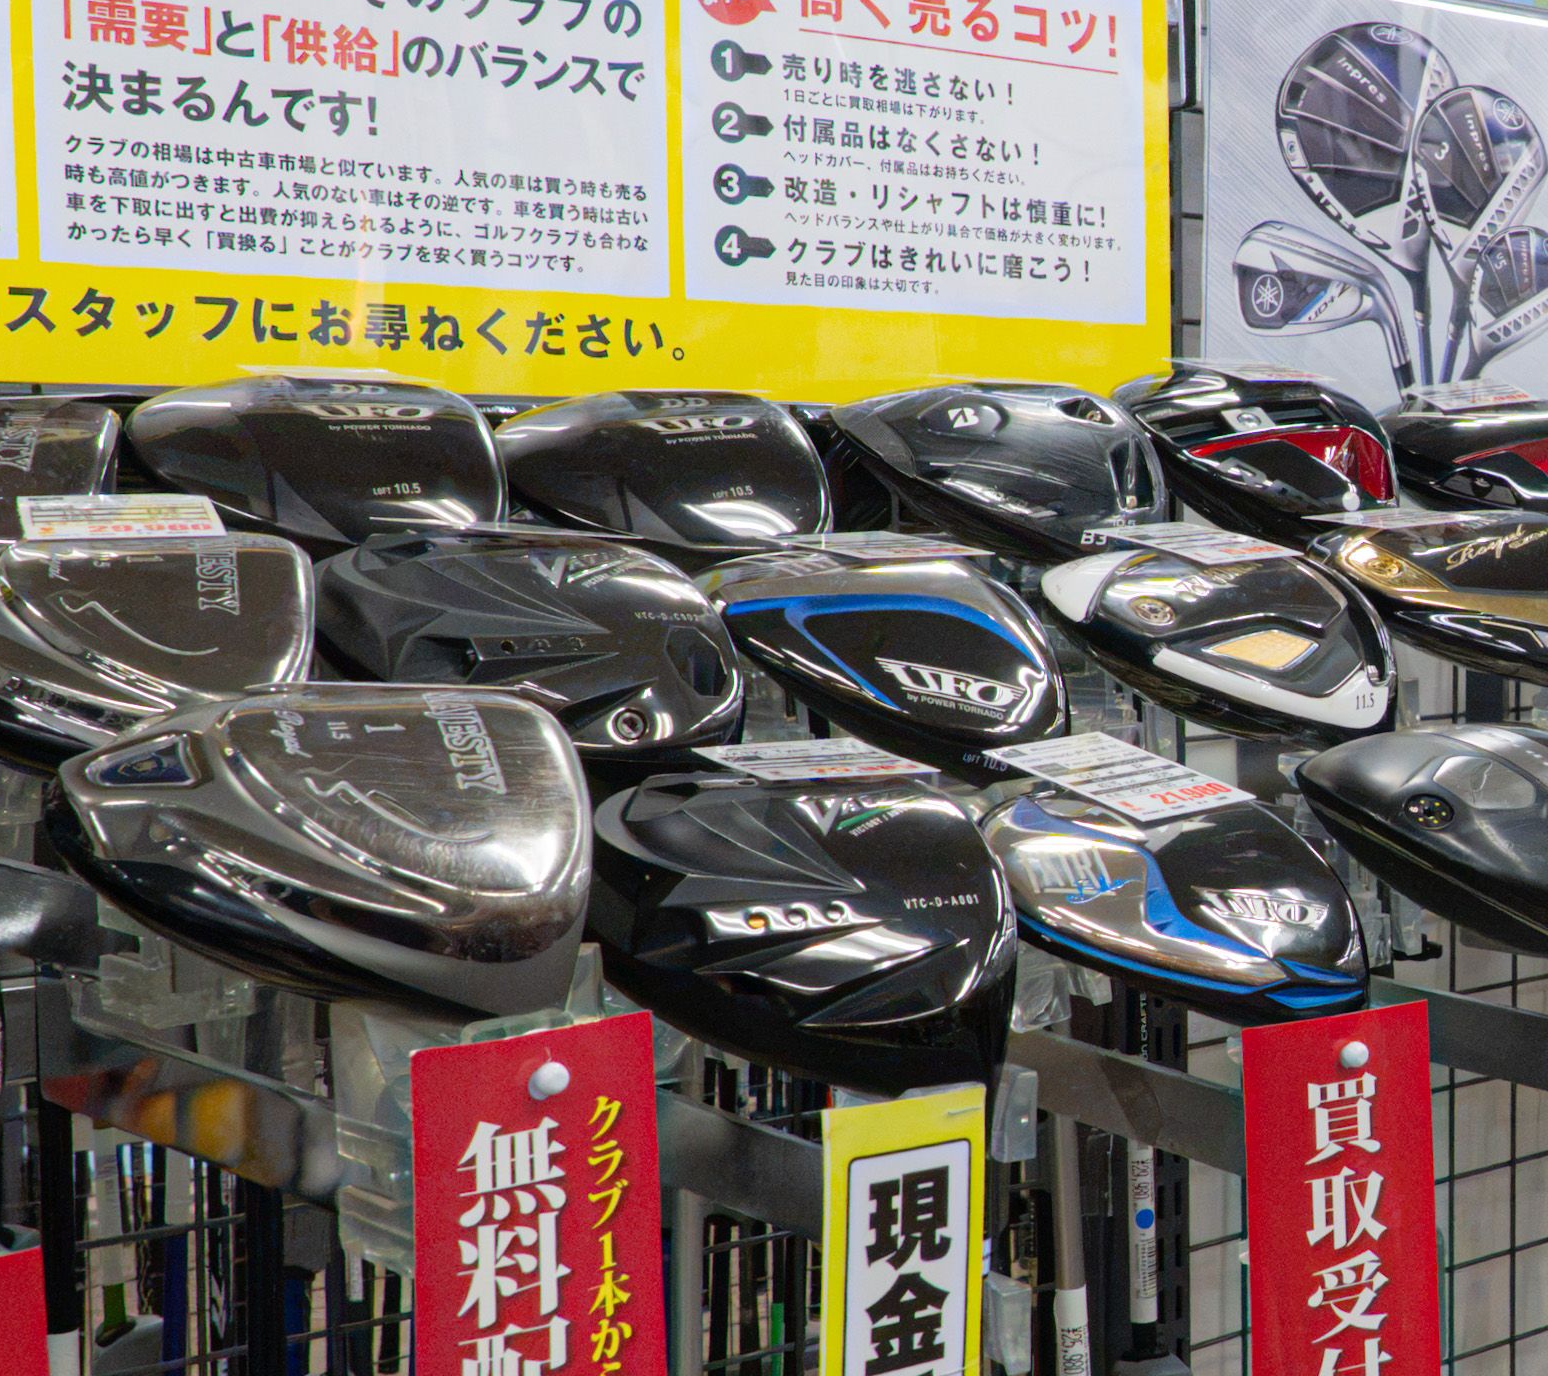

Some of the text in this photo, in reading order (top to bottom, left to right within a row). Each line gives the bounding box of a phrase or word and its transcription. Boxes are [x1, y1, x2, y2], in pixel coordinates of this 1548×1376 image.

[62, 62, 380, 136] 決まるんです!
[720, 47, 1016, 106] 1 売り時を逃さない!
[720, 109, 1040, 166] 2 付属品はなくさない!
[720, 171, 741, 198] 3
[721, 233, 1091, 284] 4 クラブはきれいに磨こう!
[394, 483, 422, 496] 10.5
[876, 656, 1028, 707] UFO
[1354, 694, 1375, 712] 11.5
[922, 694, 954, 711] POWER
[955, 700, 1006, 721] TORNADO
